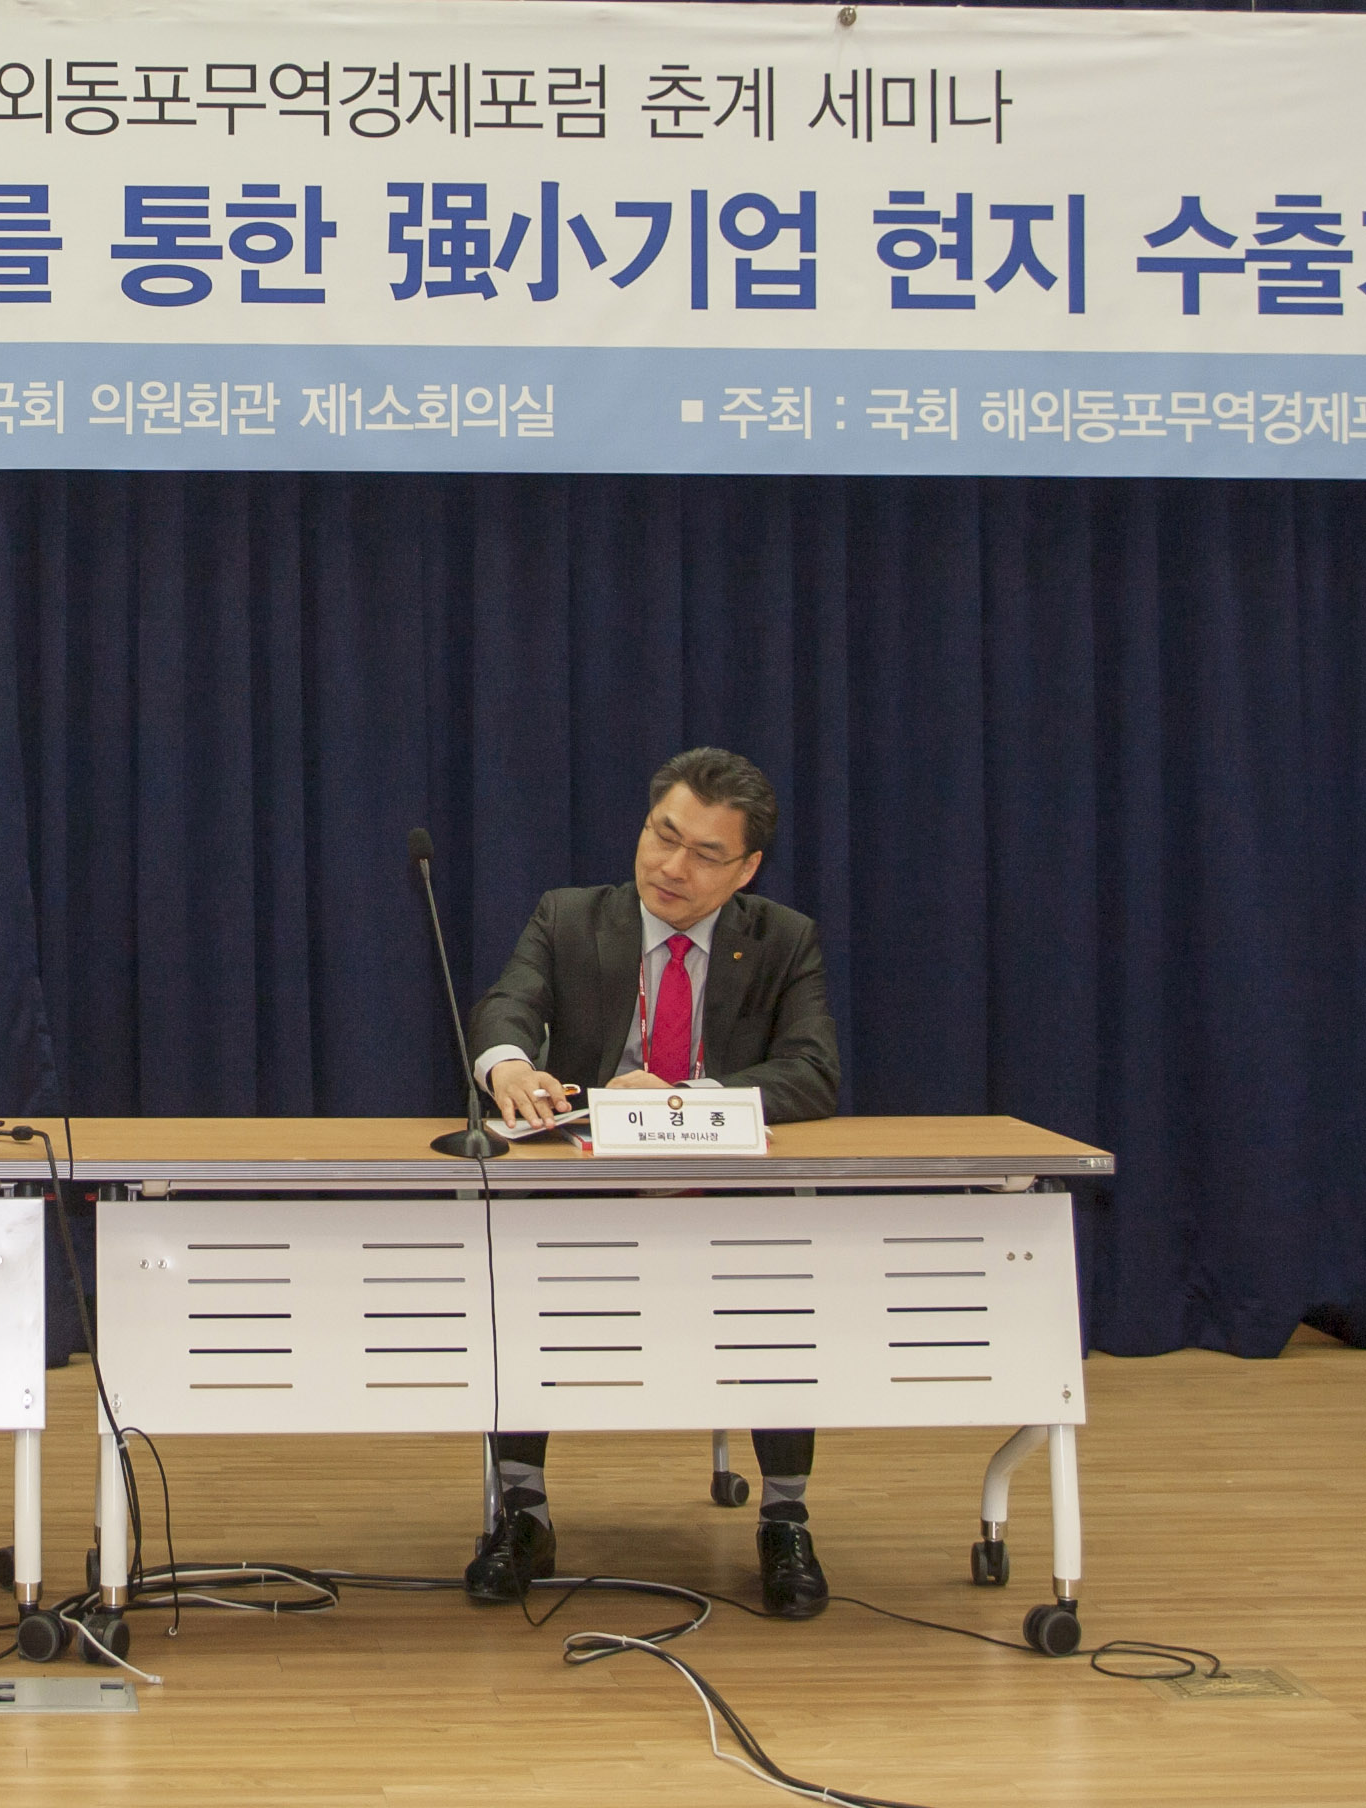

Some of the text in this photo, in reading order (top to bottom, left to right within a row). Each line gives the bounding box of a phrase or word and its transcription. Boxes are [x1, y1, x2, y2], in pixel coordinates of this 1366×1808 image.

[641, 64, 775, 142] 춘계
[808, 67, 1013, 145] 세미나
[111, 183, 337, 307] 통한
[873, 190, 1086, 314] 현지
[1137, 194, 1366, 316] 수출
[89, 380, 281, 436] 의원회관
[300, 383, 555, 438] 제1소회의실
[720, 386, 813, 440] 주최
[866, 387, 959, 441] 국회
[681, 1132, 719, 1142] 부이사장
